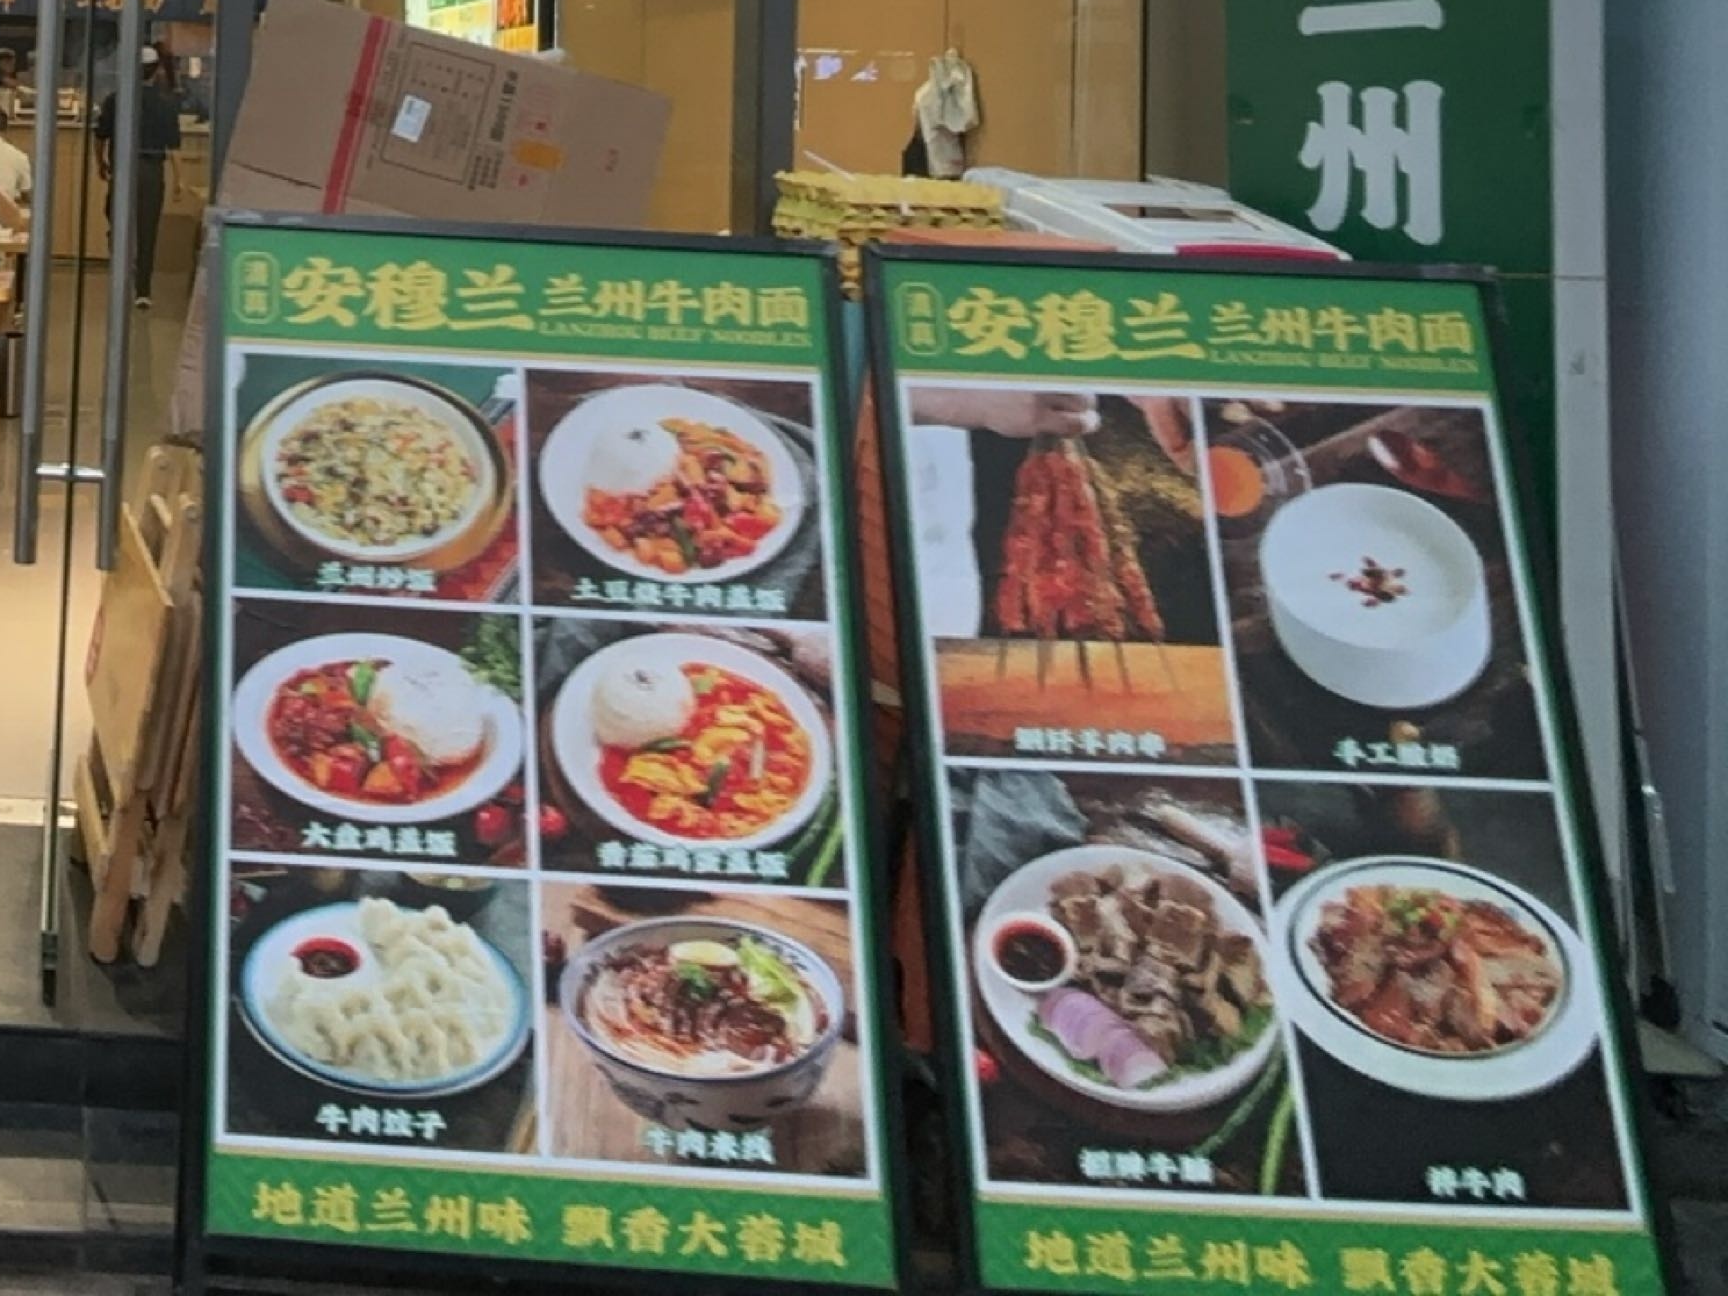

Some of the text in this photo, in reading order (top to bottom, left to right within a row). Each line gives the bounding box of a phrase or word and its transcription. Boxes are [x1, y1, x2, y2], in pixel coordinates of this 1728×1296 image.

[281, 256, 810, 331] 安穆兰 兰州牛肉面
[947, 287, 1474, 362] 安穆兰 兰州牛肉面
[316, 1103, 447, 1141] 牛肉饺子
[251, 1181, 847, 1267] 地道兰州味 飘香大蓉城
[1022, 1228, 1620, 1296] 地道兰州味 飘香大蓉城
